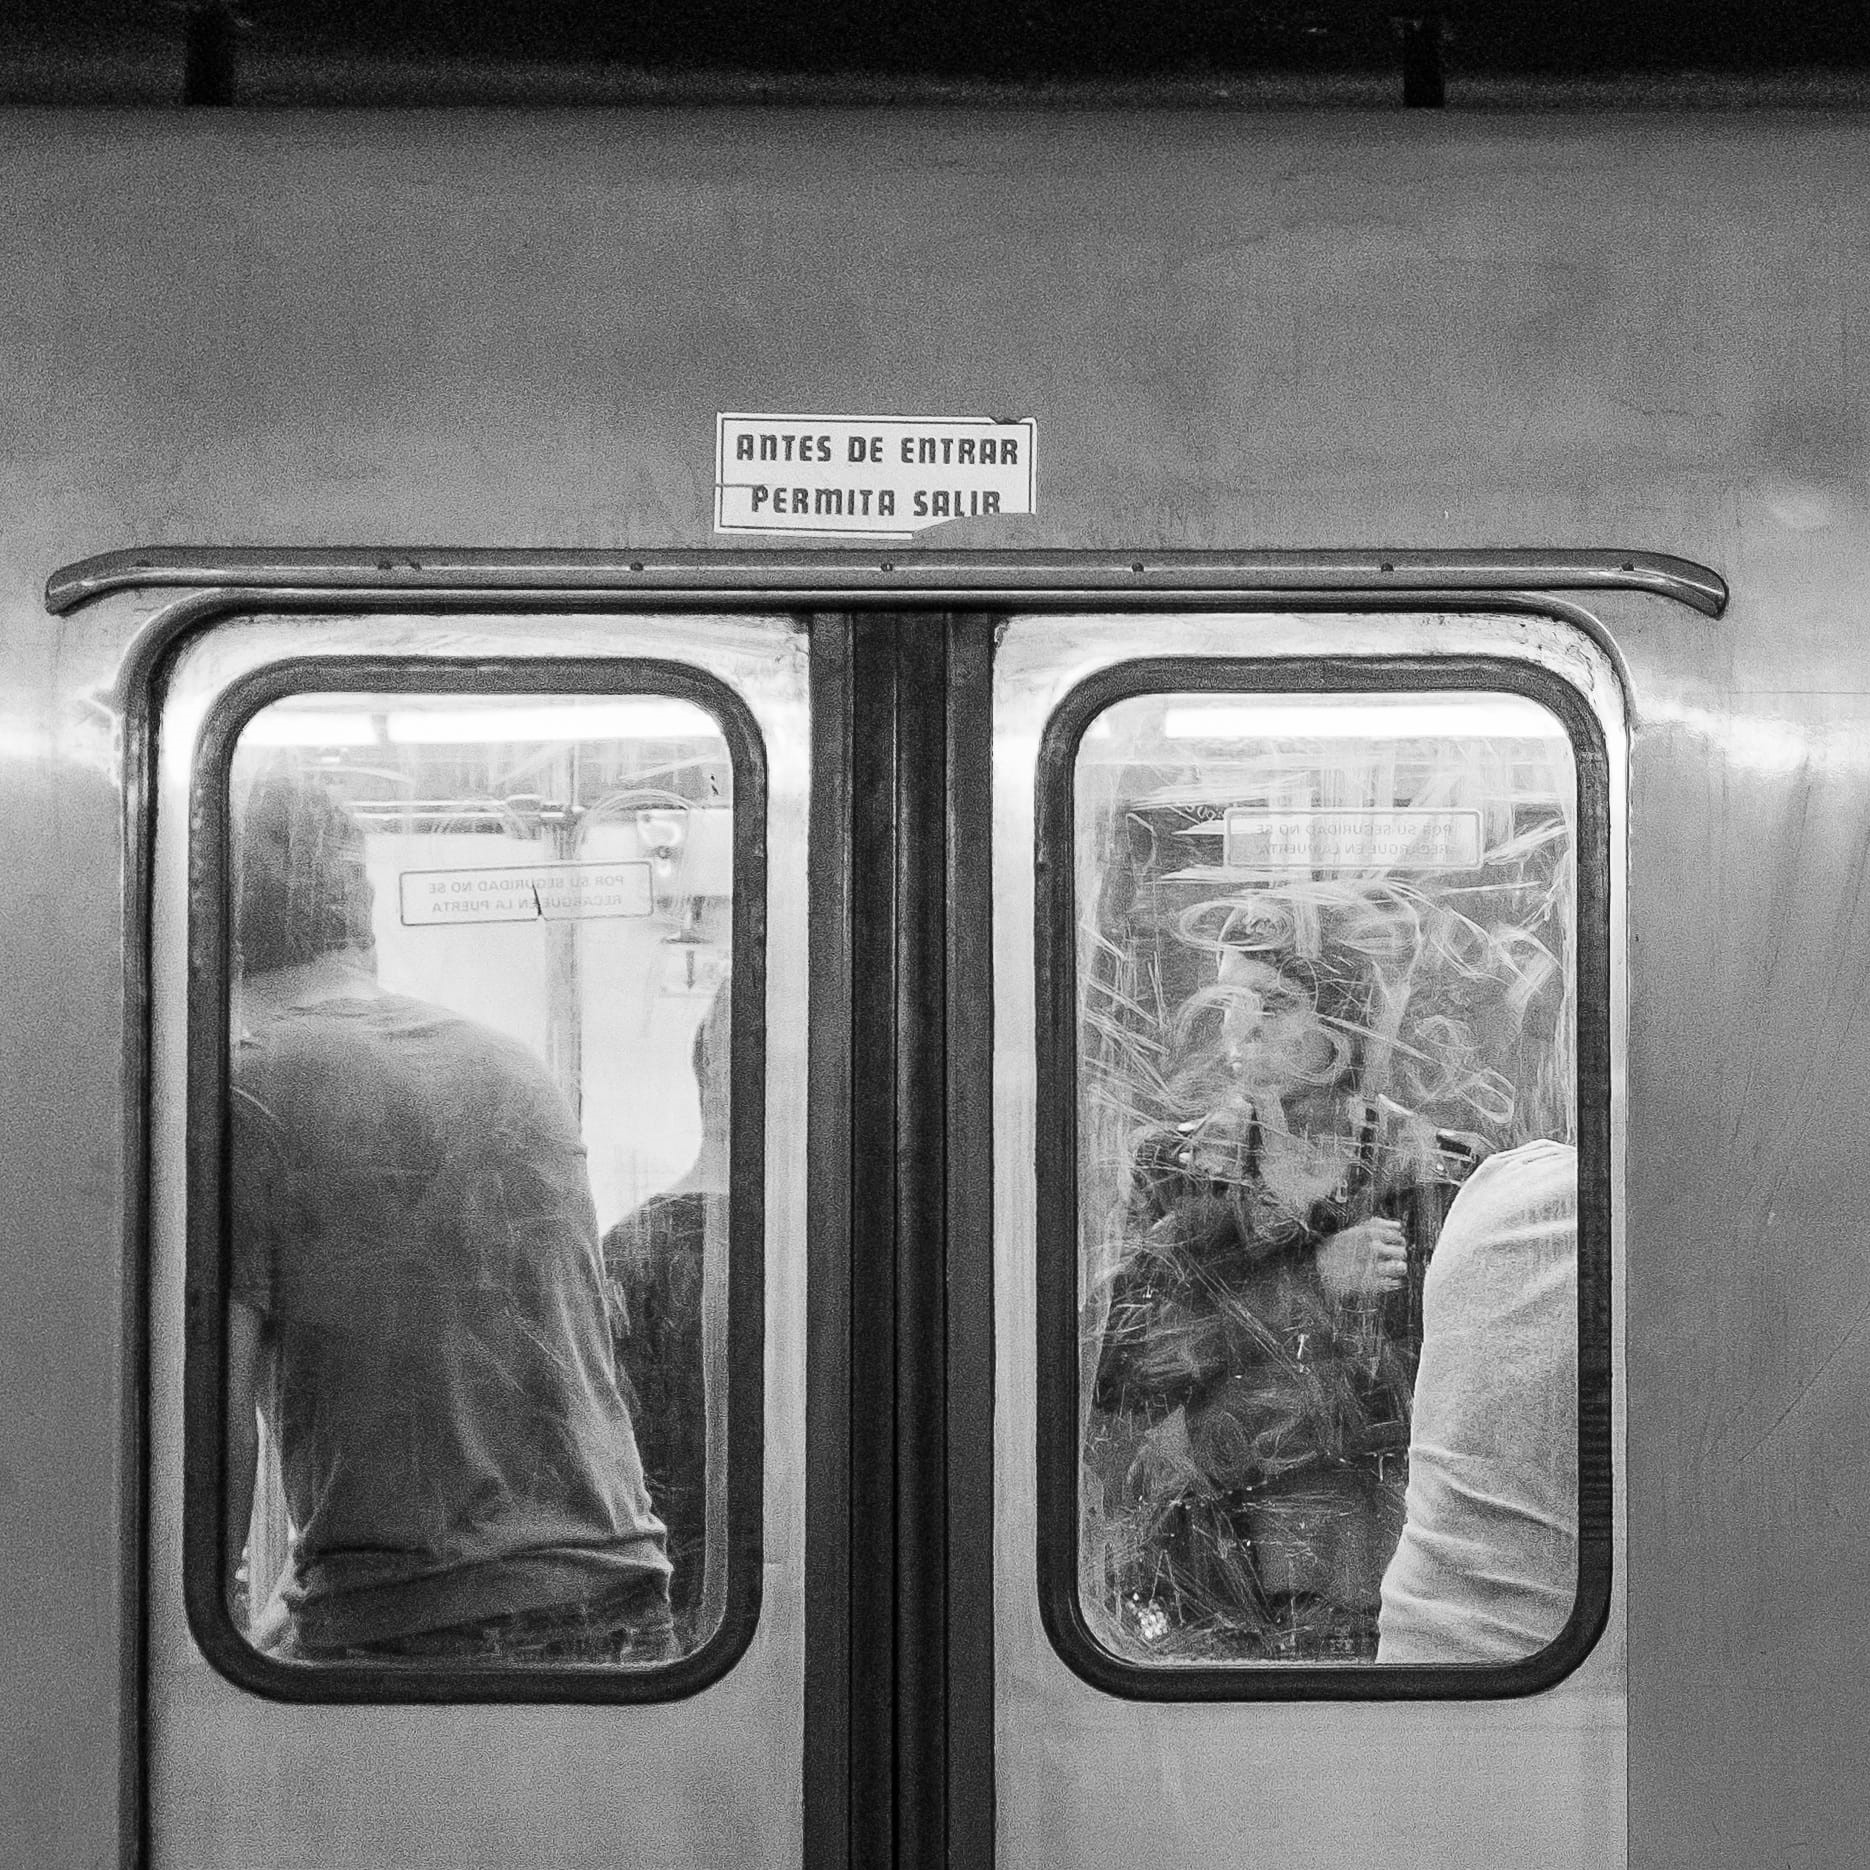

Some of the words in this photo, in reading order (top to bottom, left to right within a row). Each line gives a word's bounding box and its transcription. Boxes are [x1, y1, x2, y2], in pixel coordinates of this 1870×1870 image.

[737, 434, 831, 461] ANTES
[848, 436, 883, 463] DE
[901, 437, 1018, 465] ENTRAR
[751, 486, 895, 516] PERMITA
[913, 490, 1001, 517] SALIR
